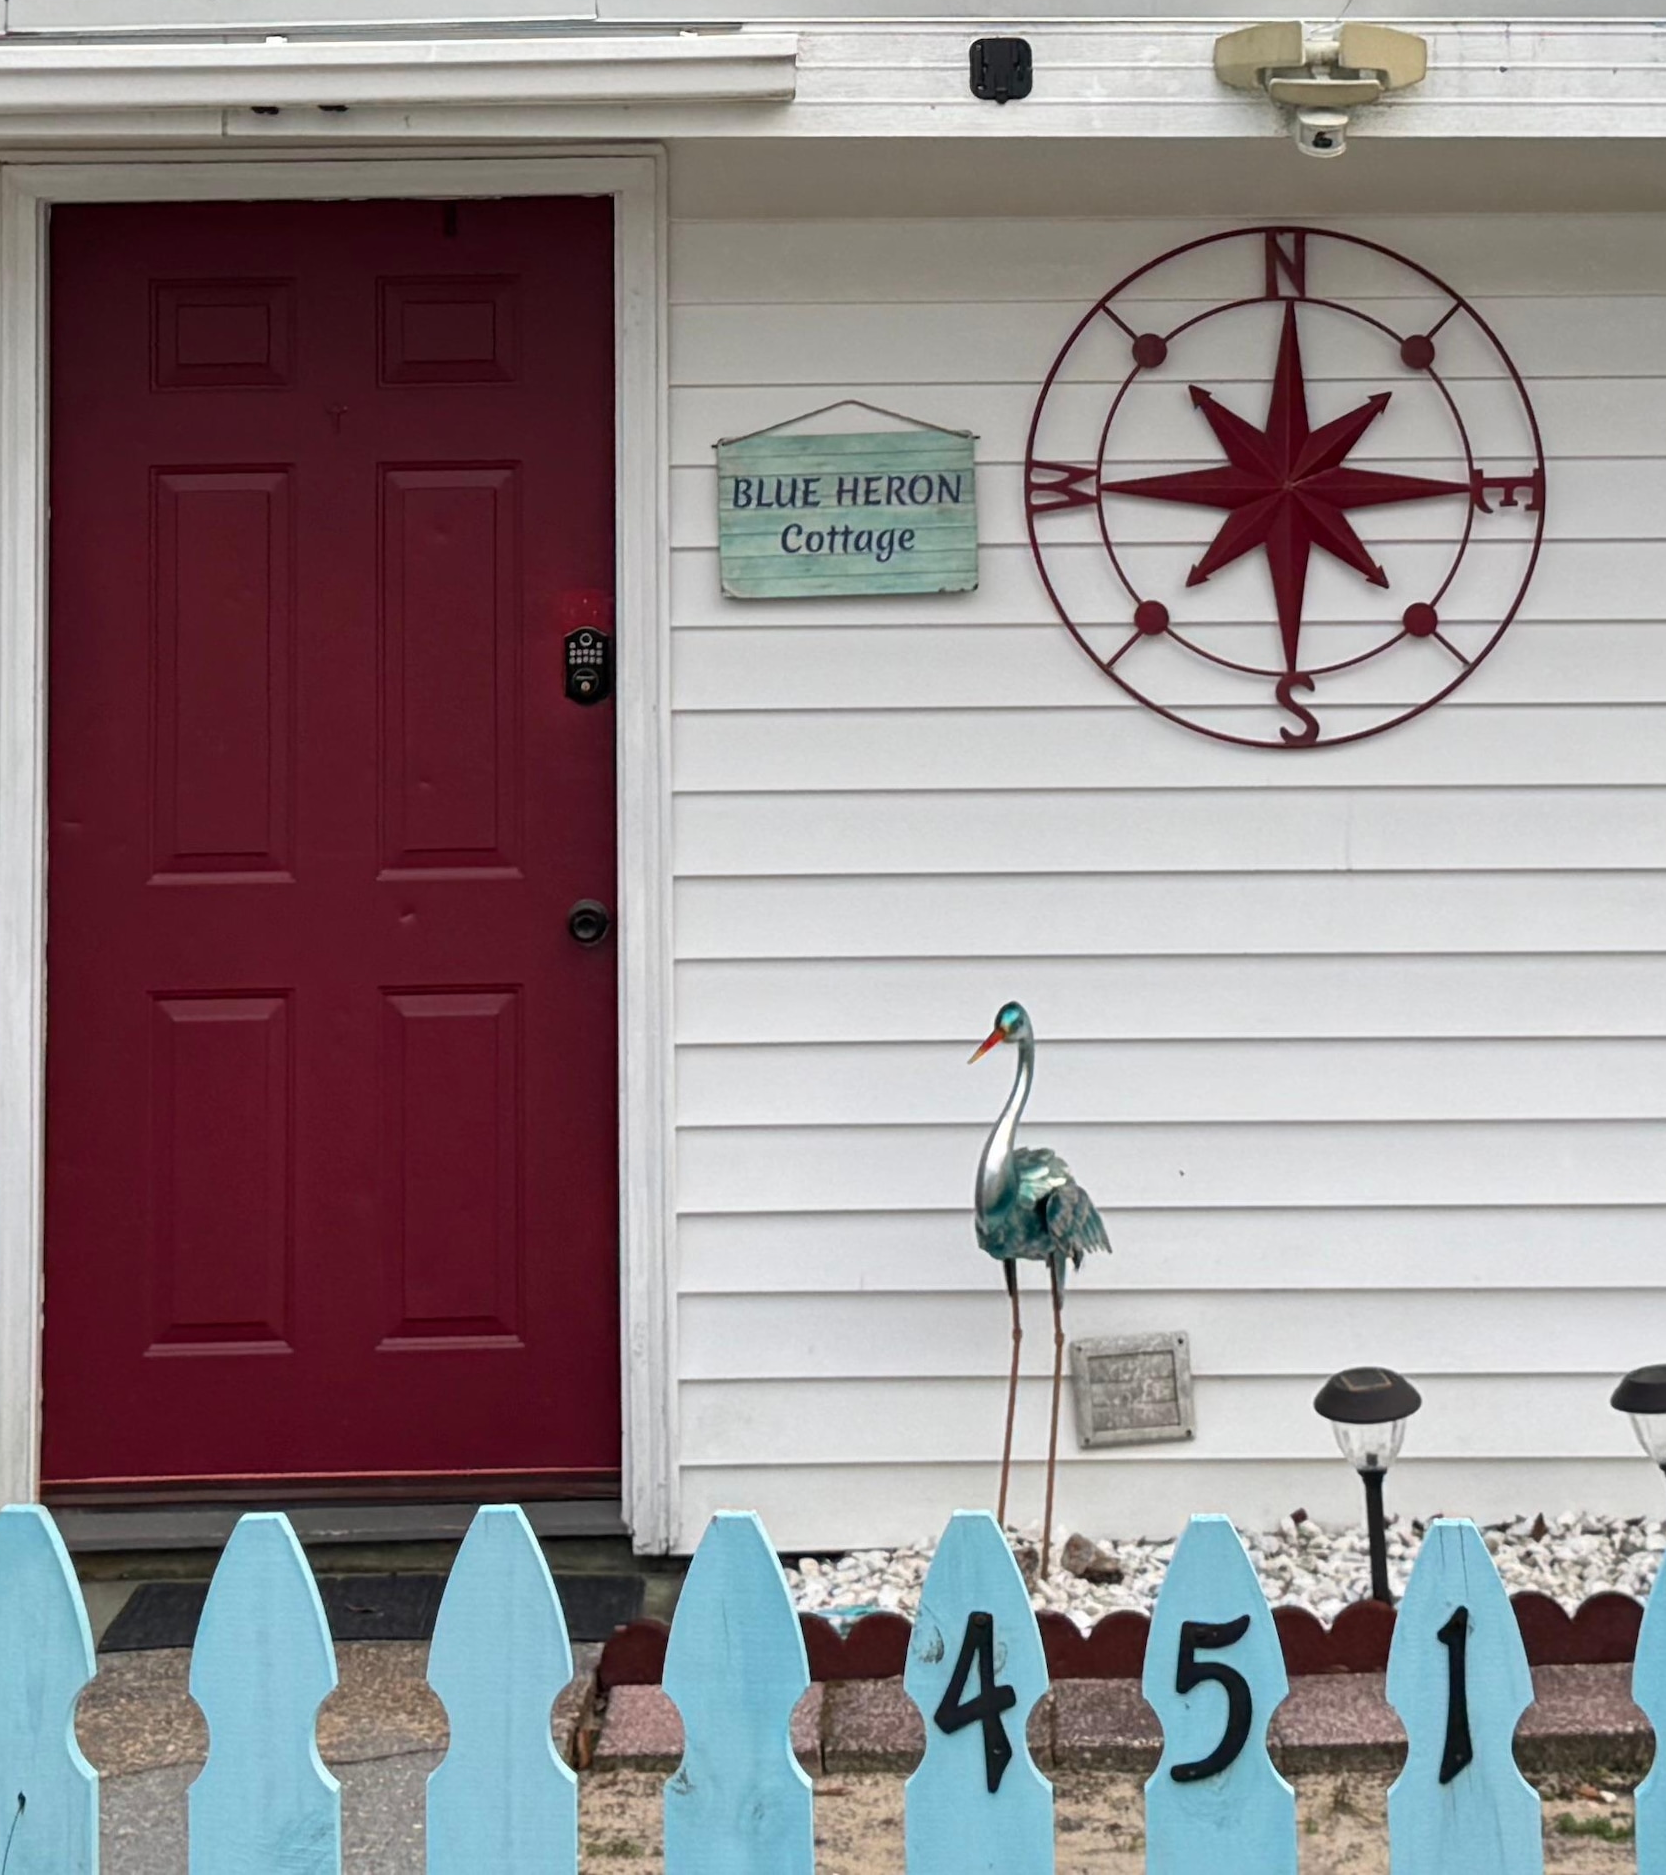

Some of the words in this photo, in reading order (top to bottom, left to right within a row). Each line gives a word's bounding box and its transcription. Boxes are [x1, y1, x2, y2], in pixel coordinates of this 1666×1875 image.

[733, 476, 822, 508] BLUE
[836, 474, 962, 506] HERON
[781, 523, 915, 562] Cottage
